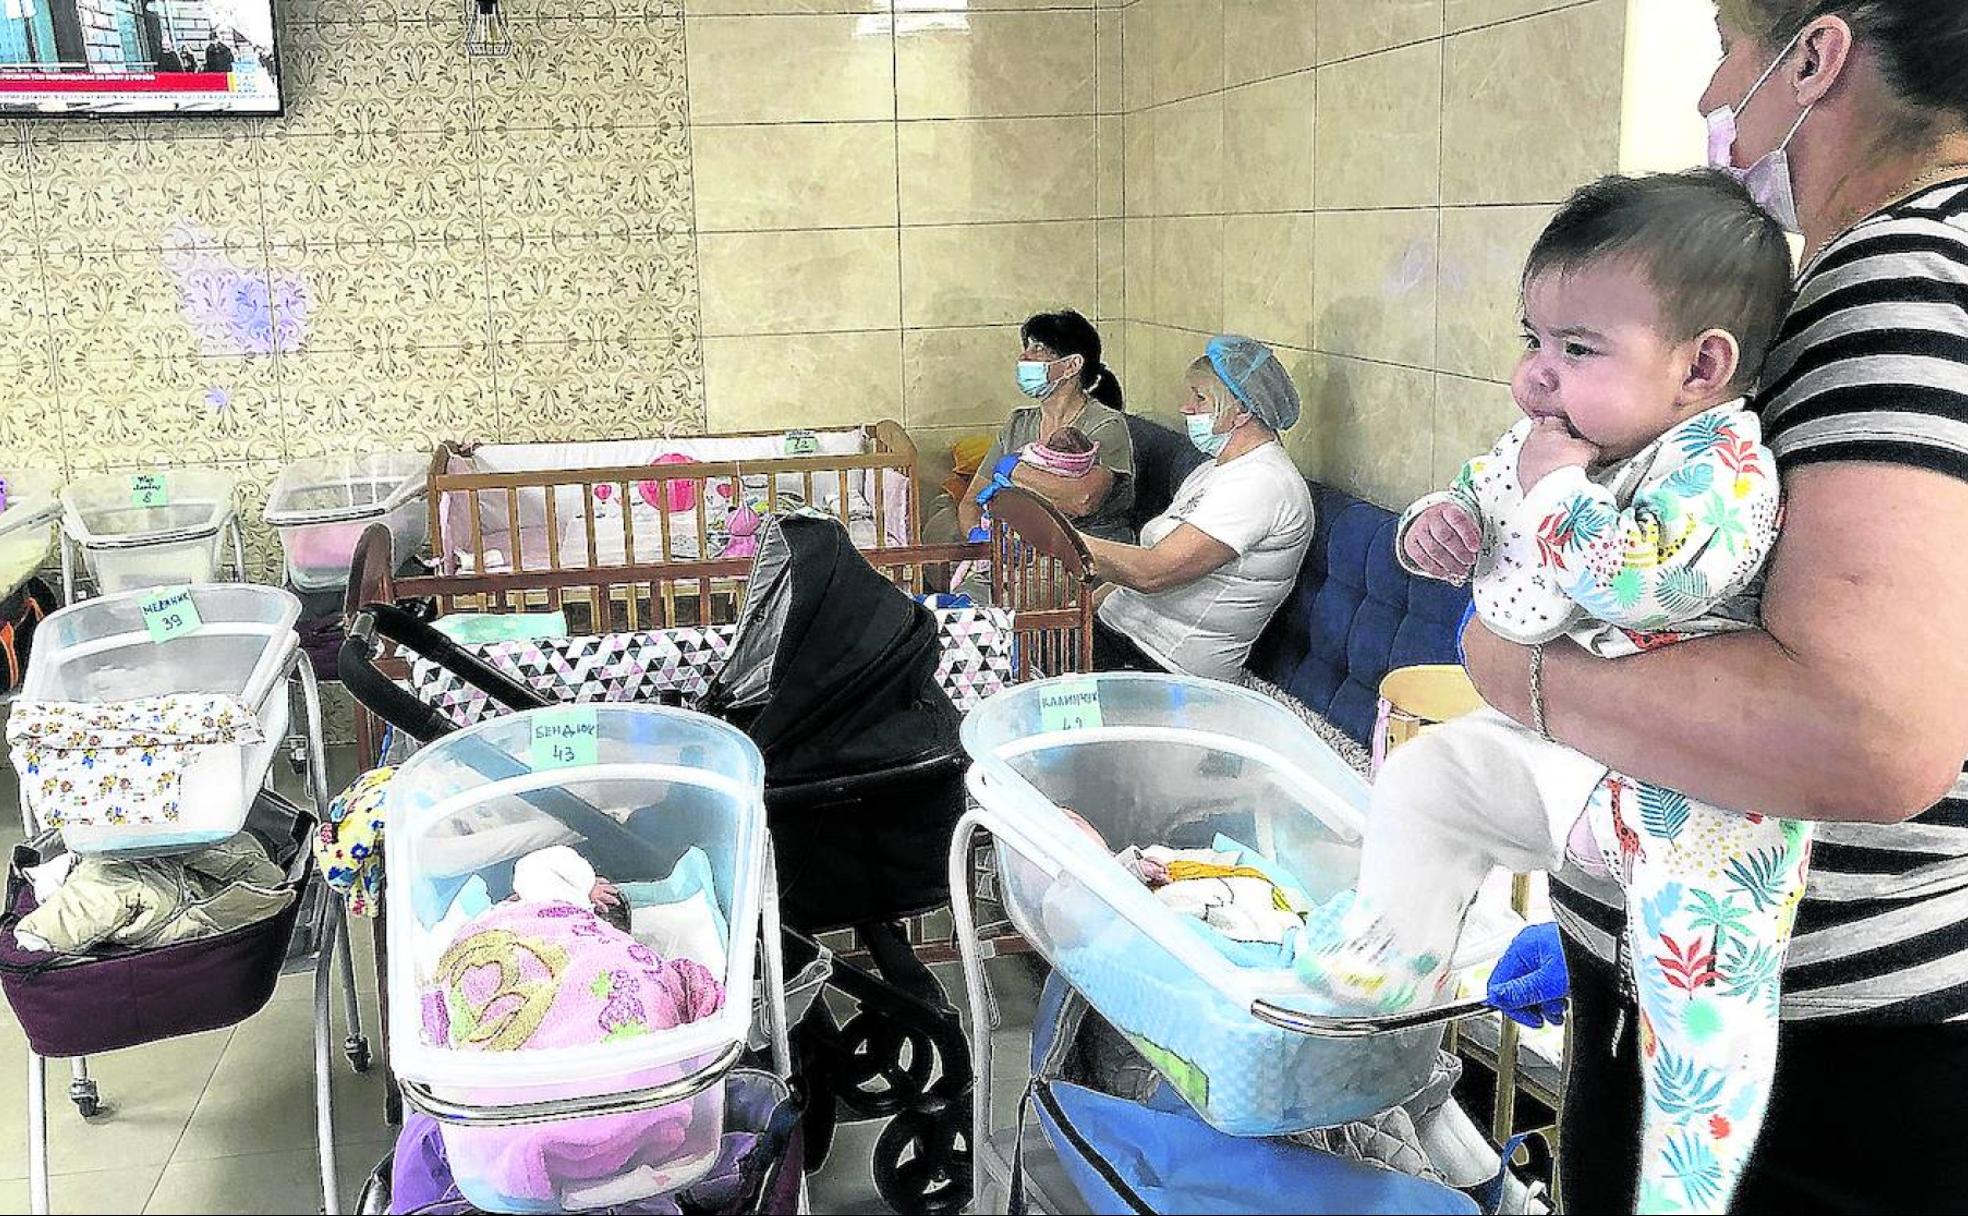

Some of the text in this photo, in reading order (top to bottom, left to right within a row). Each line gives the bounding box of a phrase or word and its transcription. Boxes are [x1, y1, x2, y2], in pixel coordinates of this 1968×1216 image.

[162, 614, 183, 631] 39
[535, 724, 595, 739] БЕНДЮК
[553, 744, 575, 762] 43
